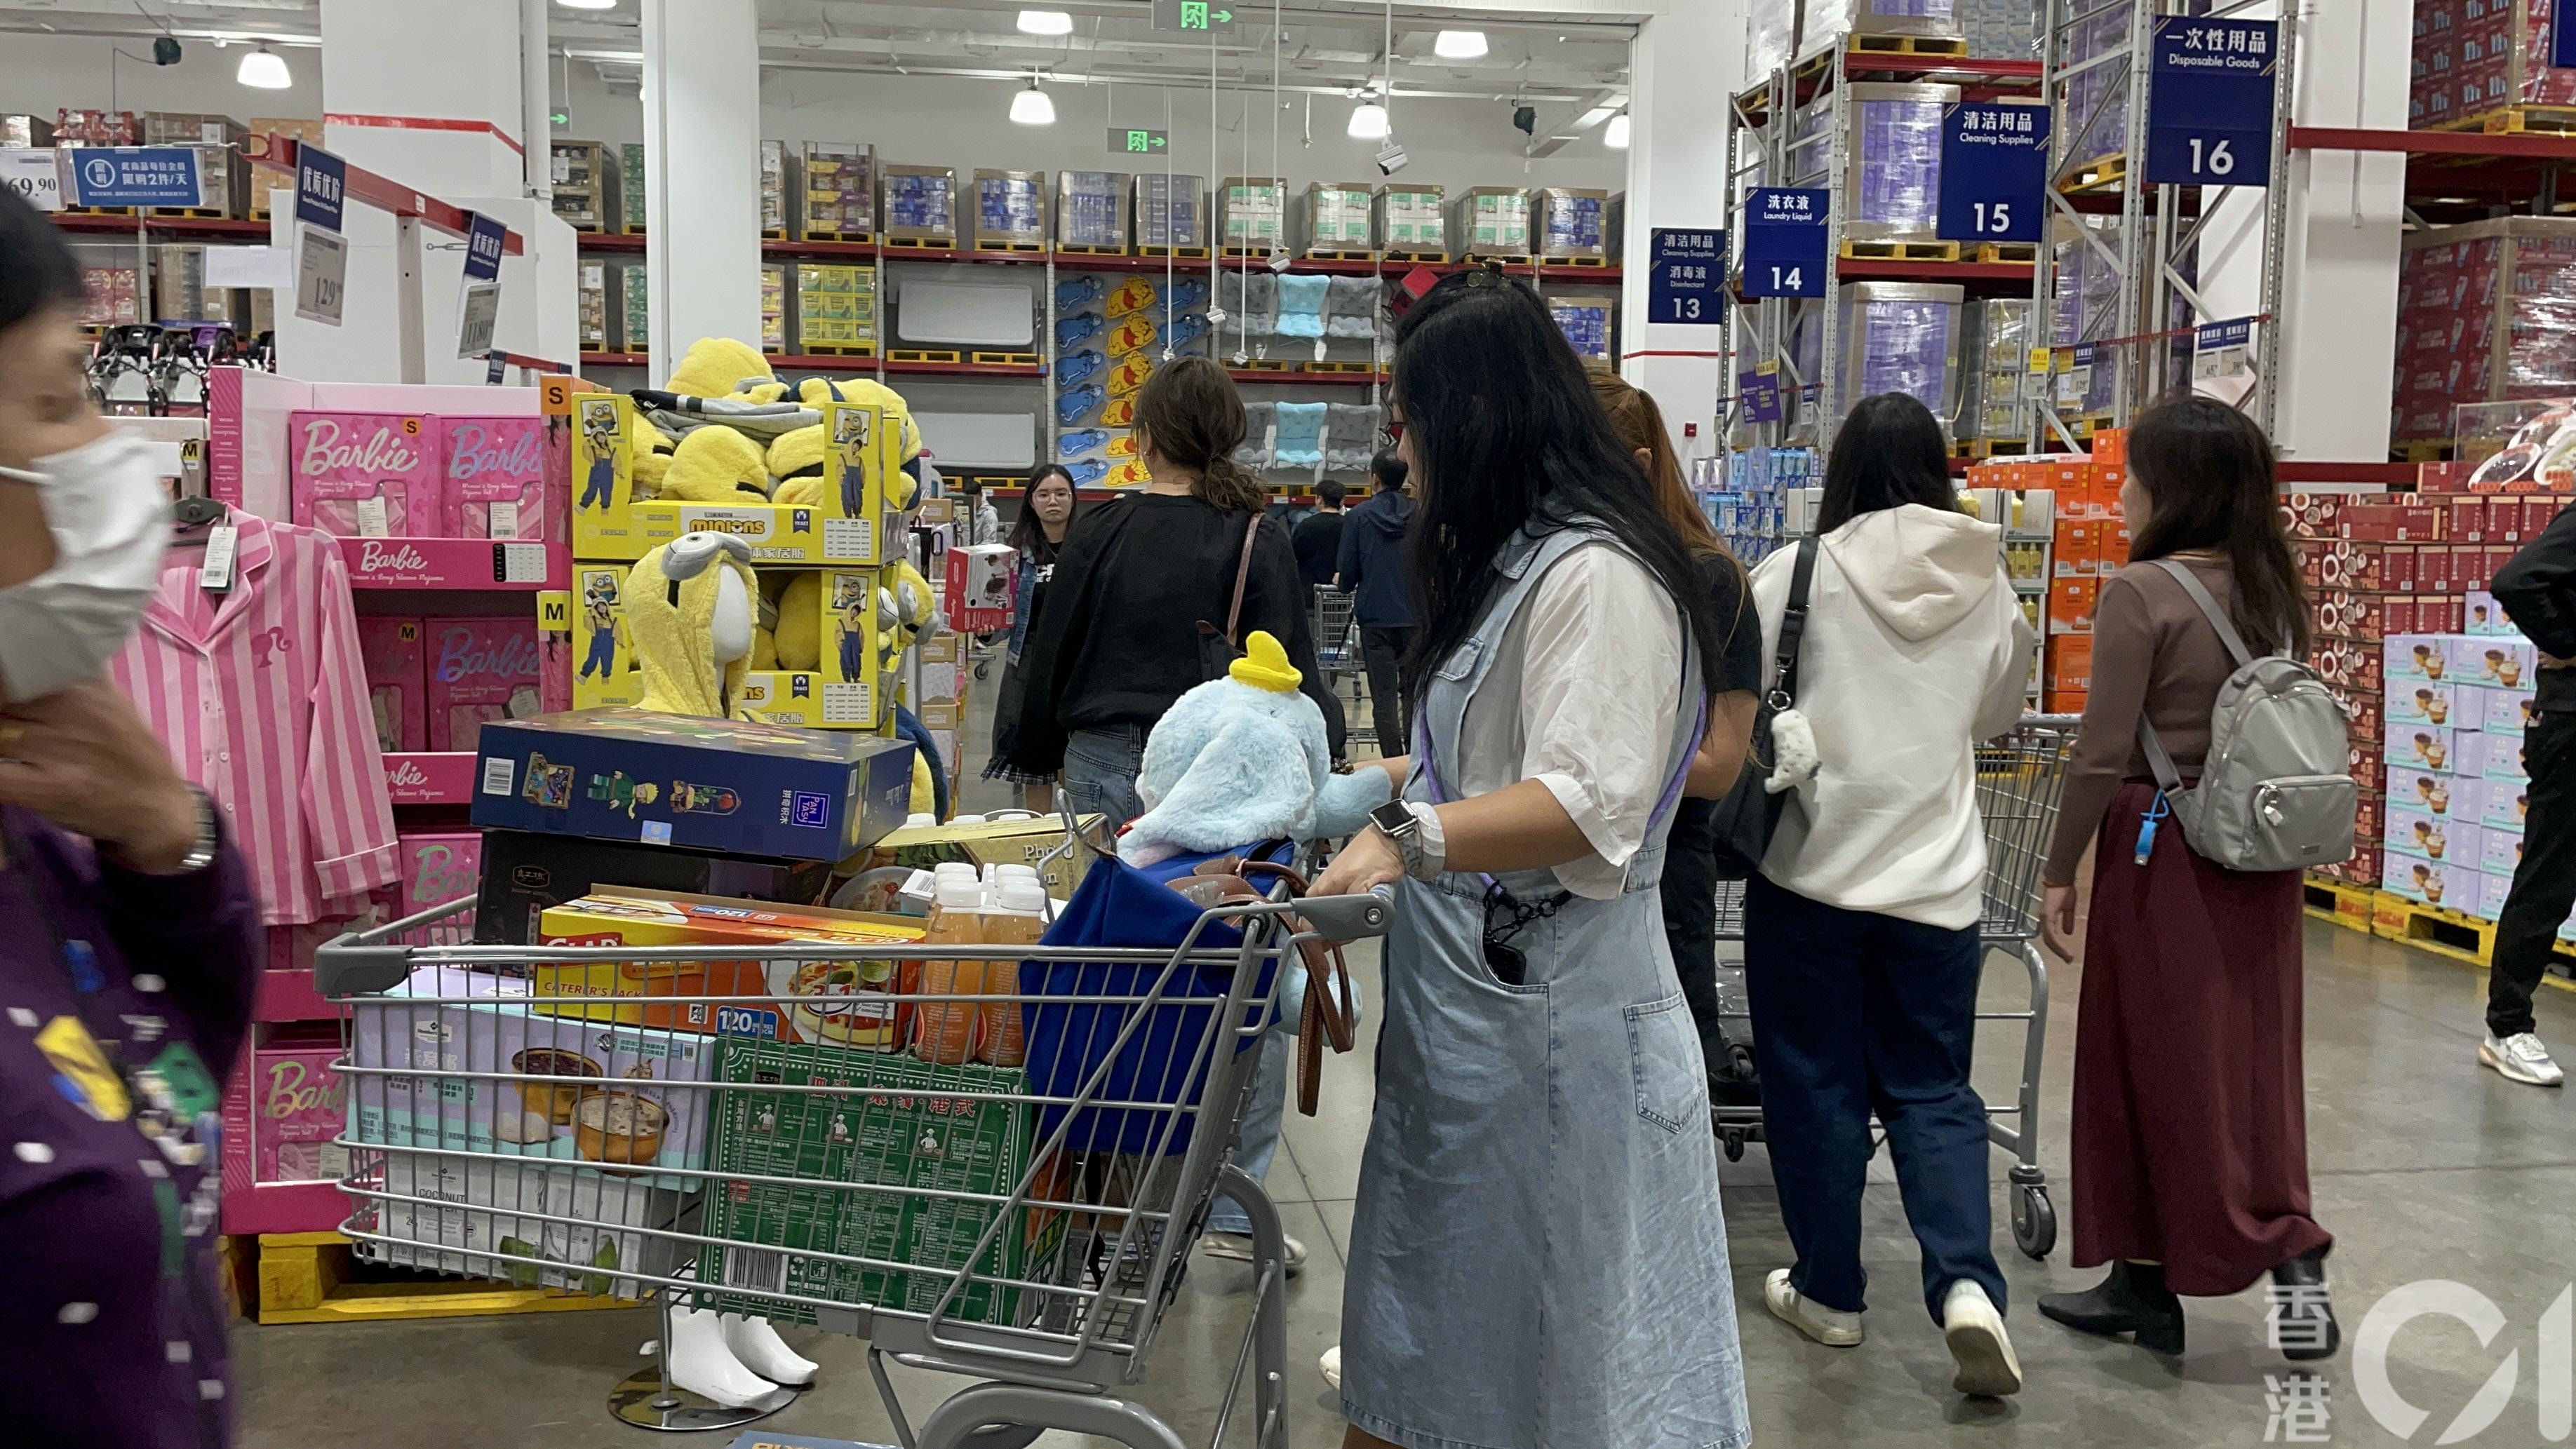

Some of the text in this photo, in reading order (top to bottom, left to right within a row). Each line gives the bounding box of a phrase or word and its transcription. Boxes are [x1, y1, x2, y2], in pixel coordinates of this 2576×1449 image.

[2166, 28, 2266, 53] 一次性用品
[2168, 53, 2260, 69] Disposable Goods
[1963, 111, 2032, 132] 清洁用品
[1959, 132, 2034, 146] Cleaning Supplies
[2189, 138, 2234, 175] 16
[302, 166, 342, 204] 优质优价
[1768, 194, 1809, 210] 洗衣液
[1764, 212, 1813, 222] Laundry Liquid
[1974, 203, 2010, 232] 15
[1664, 234, 1714, 248] 清洁用品
[1662, 249, 1715, 258] Cleaning Supplies
[1670, 266, 1706, 279] 消毒液
[1771, 267, 1802, 290] 14
[1673, 297, 1700, 319] 13
[549, 386, 564, 405] S
[406, 421, 417, 433] S
[183, 443, 199, 457] M
[300, 420, 420, 476] Barbie
[448, 424, 543, 480] Barbi
[360, 541, 428, 572] Barbie
[545, 602, 564, 620] M
[401, 626, 415, 639] M
[385, 761, 428, 786] rbie
[719, 1009, 753, 1033] 120
[419, 1189, 466, 1204] COCONUT
